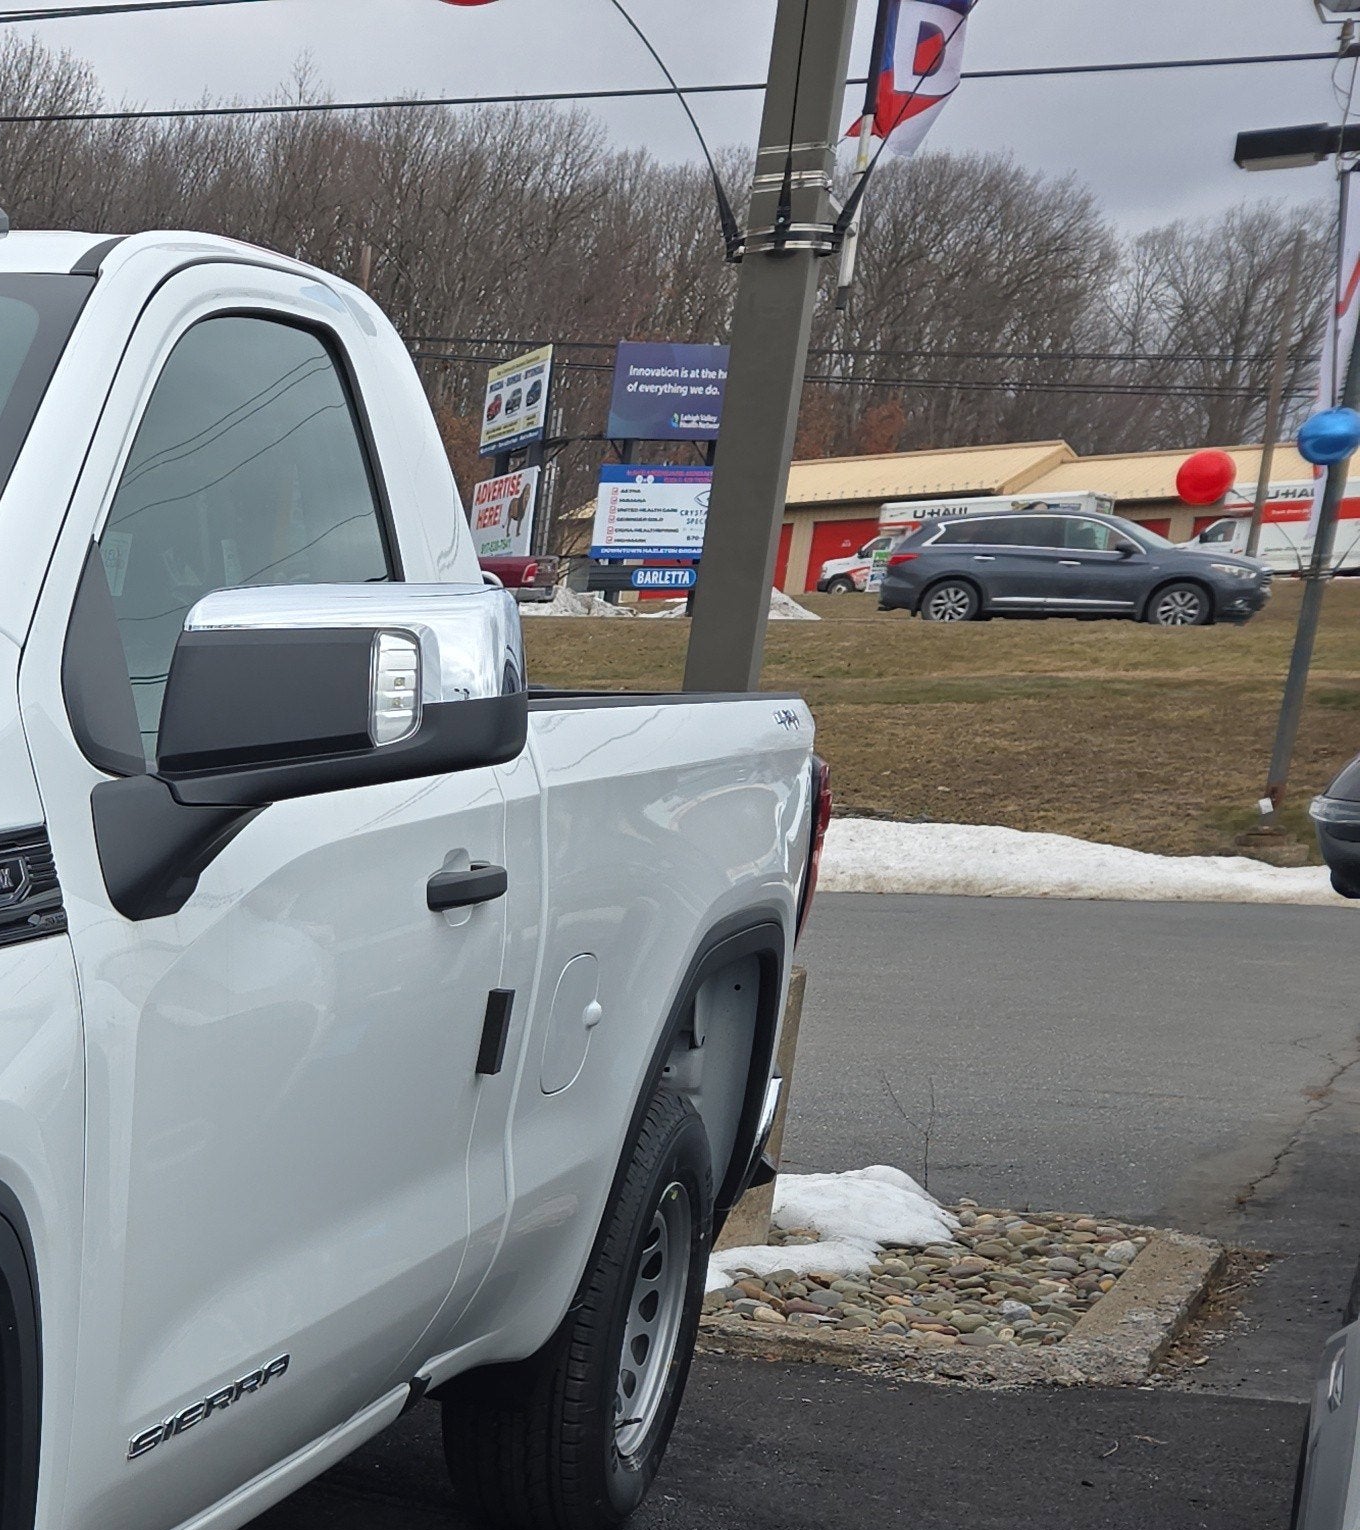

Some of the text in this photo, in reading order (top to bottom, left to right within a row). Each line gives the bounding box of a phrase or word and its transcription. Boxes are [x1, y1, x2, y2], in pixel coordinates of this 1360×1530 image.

[629, 364, 679, 378] Innovation
[680, 366, 689, 378] is
[689, 368, 700, 379] at
[701, 368, 717, 379] the
[626, 381, 639, 393] of
[638, 383, 689, 396] everything
[689, 386, 704, 395] we
[475, 472, 524, 506] ADVERTISE
[475, 503, 504, 530] HERE!
[636, 570, 690, 585] BARLETTA
[126, 1351, 292, 1461] SIERRA
